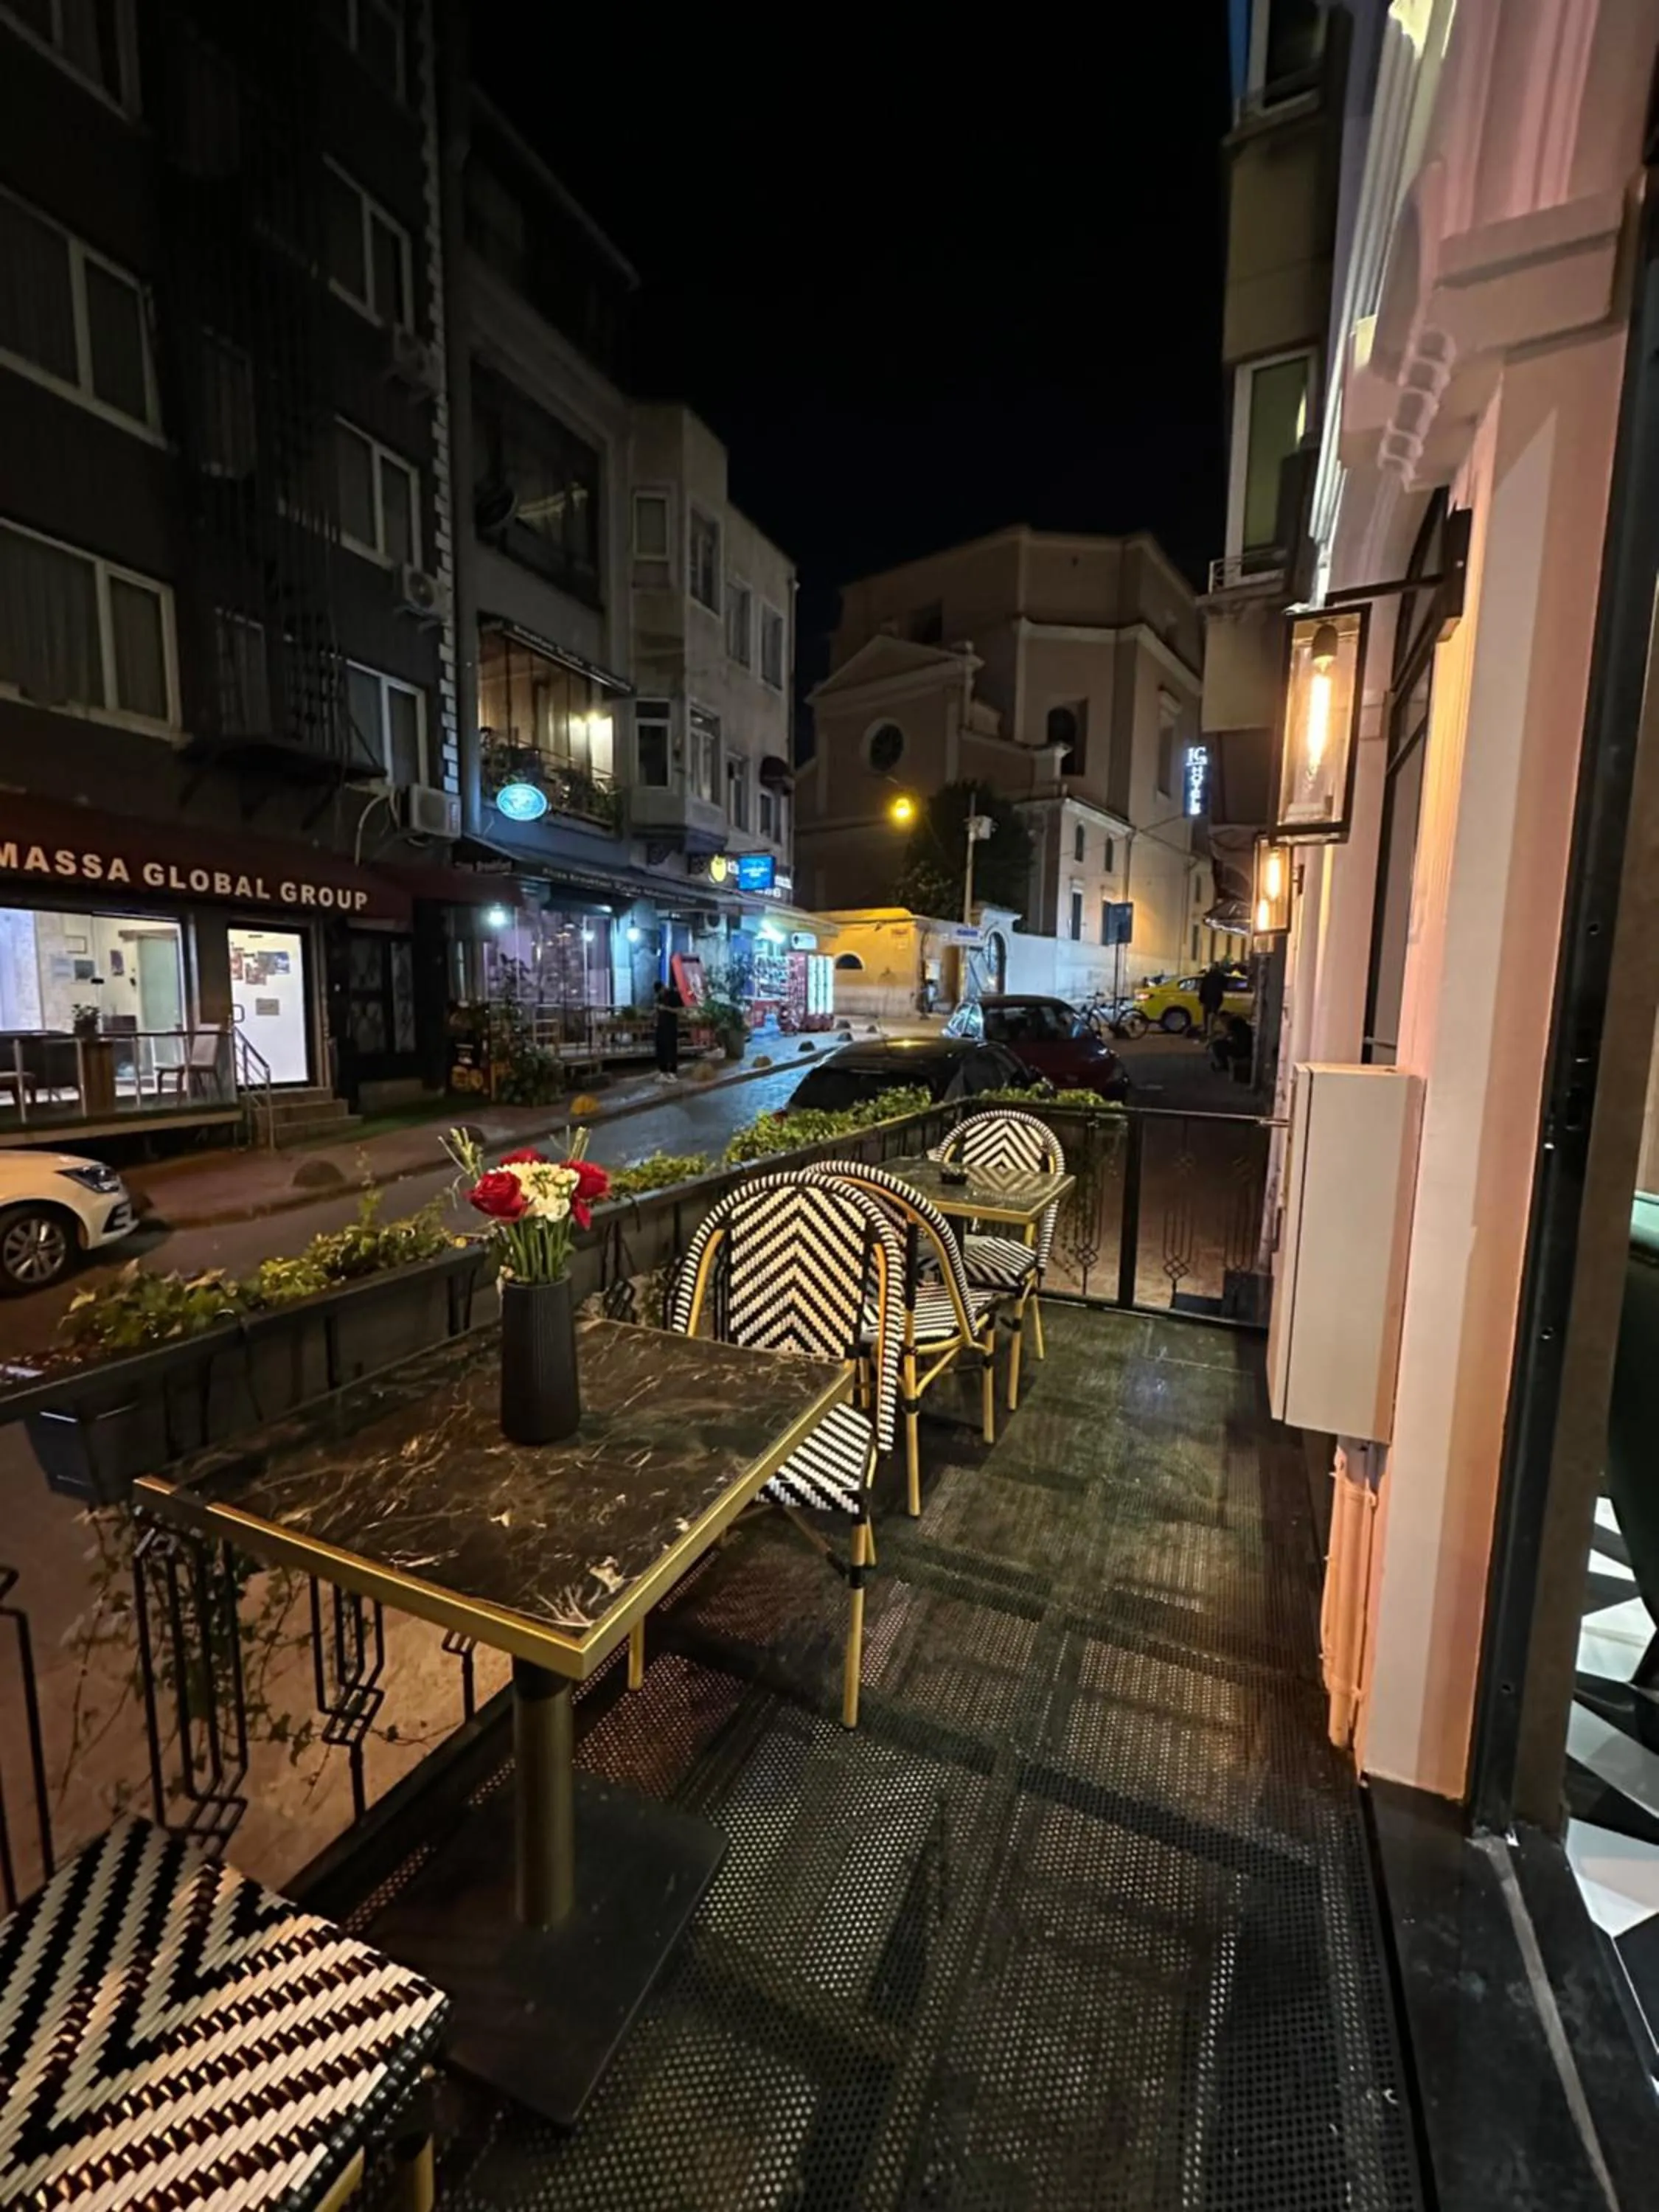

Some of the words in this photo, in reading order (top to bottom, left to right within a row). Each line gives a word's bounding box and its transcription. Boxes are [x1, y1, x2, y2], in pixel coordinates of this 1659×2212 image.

[1189, 766, 1203, 815] HOTEL
[0, 841, 130, 883] MASSA
[143, 862, 271, 900] GLOBAL
[280, 881, 367, 911] GROUP
